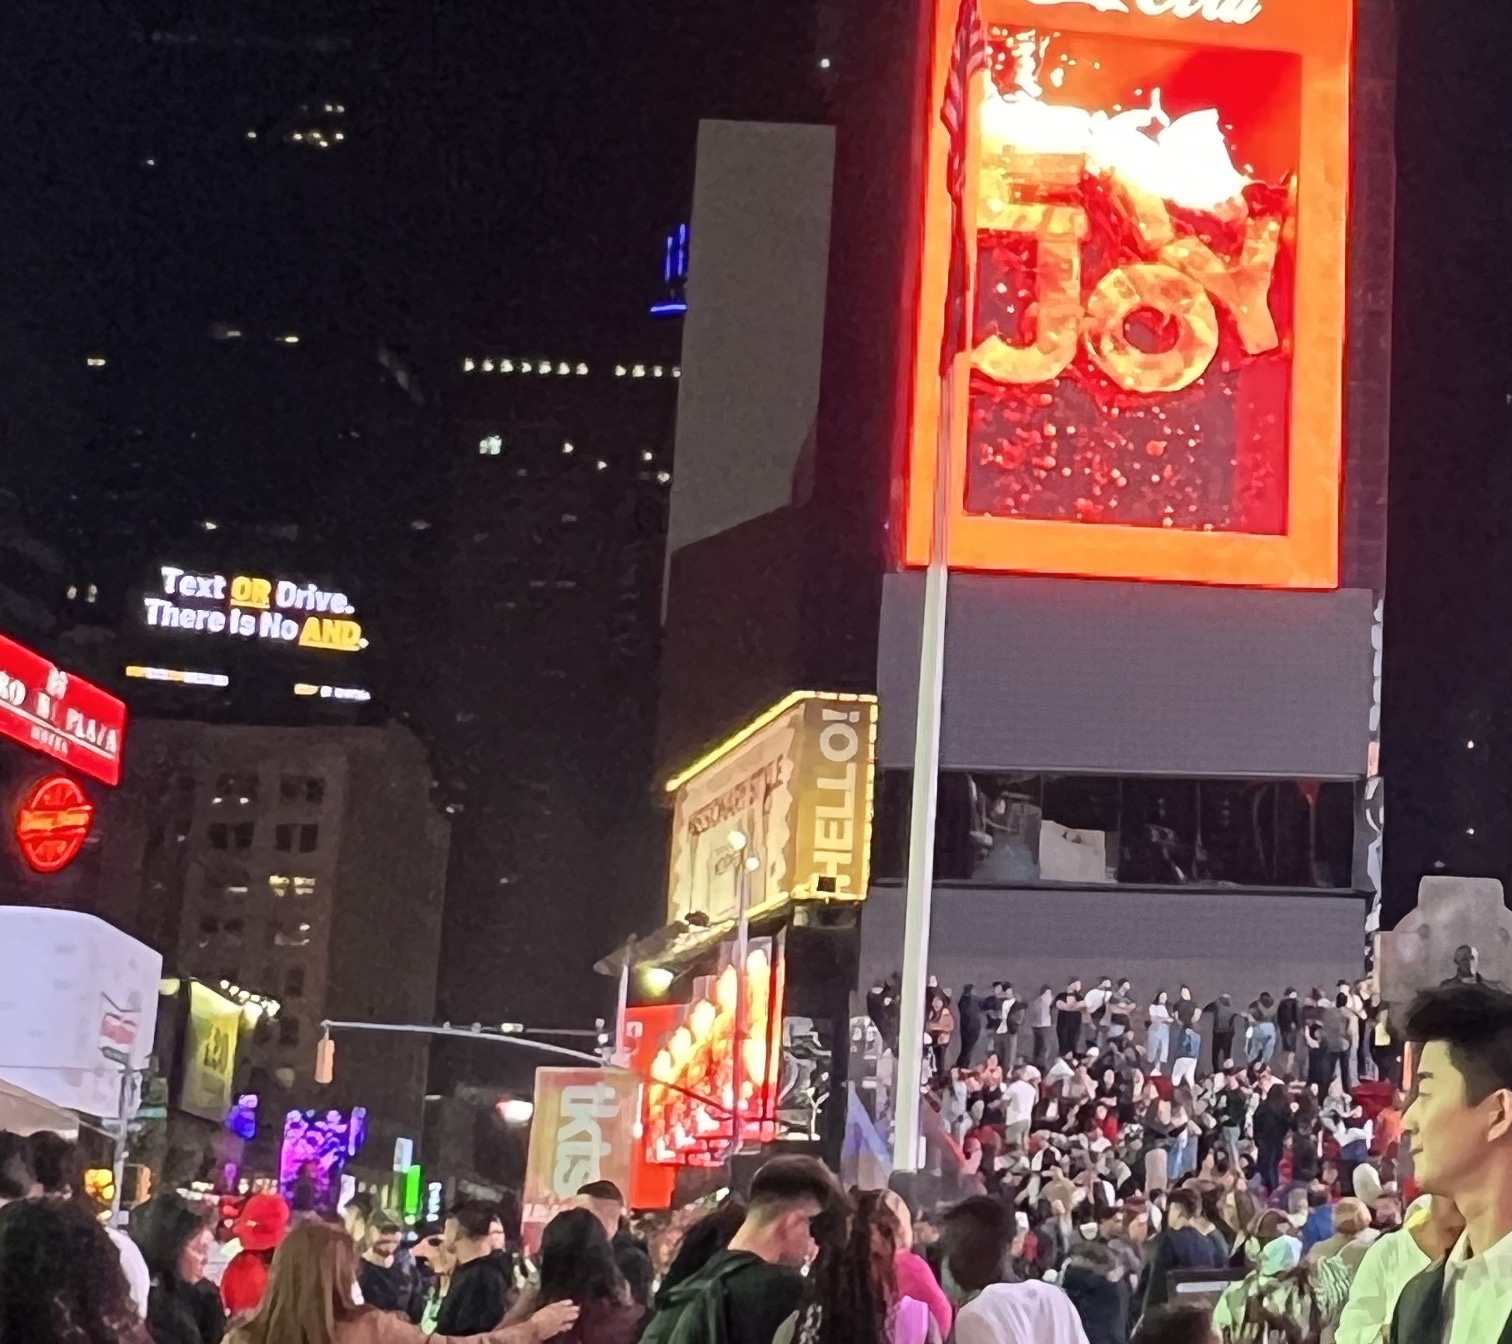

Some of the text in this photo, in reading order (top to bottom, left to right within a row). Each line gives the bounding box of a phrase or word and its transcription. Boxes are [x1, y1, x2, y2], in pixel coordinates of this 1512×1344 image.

[970, 176, 1281, 393] JOY
[144, 597, 226, 632] There
[259, 611, 300, 641] No
[299, 616, 369, 650] AND.
[161, 566, 356, 615] Text OR Drive.
[813, 708, 868, 890] HELLO!
